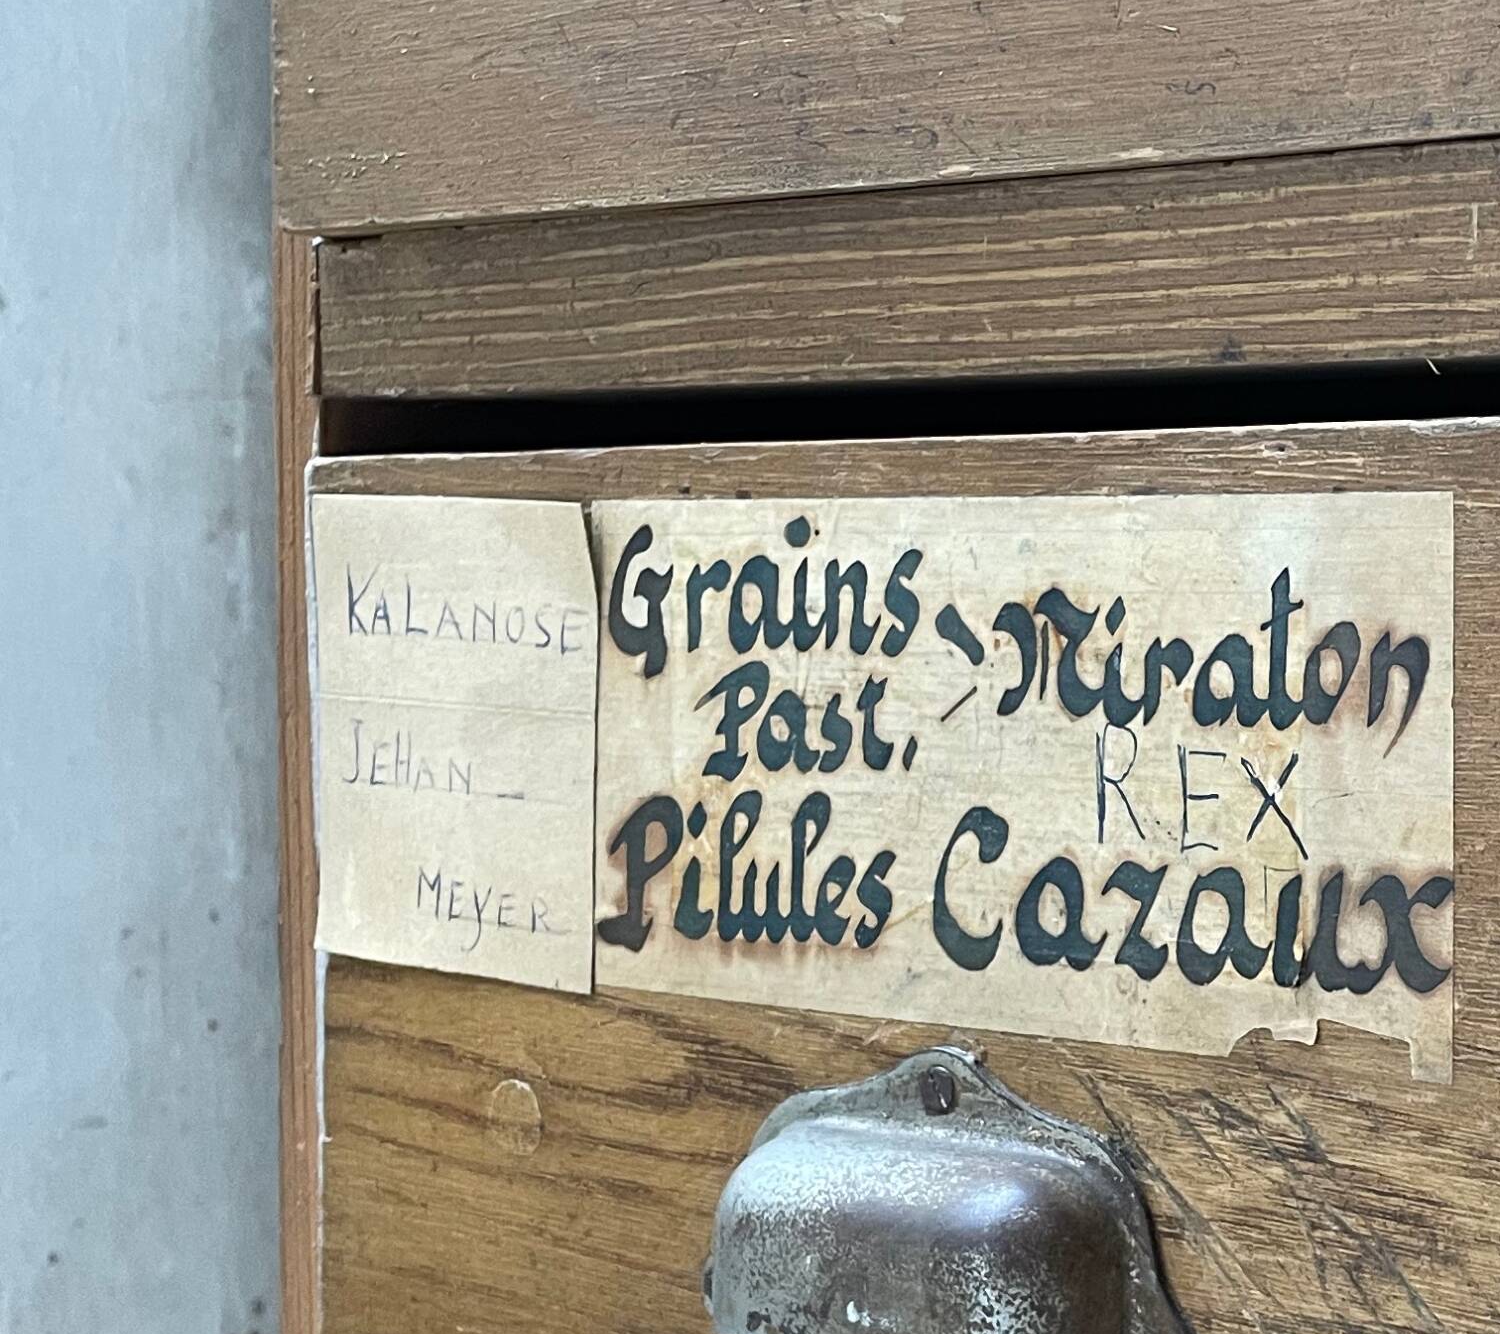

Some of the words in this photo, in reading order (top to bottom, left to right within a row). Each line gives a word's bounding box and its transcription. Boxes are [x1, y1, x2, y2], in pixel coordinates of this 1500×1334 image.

[344, 561, 590, 656] KALANOSE
[608, 515, 924, 679] Grains
[991, 566, 1431, 759] Miraton
[342, 717, 474, 797] JEHAN
[1094, 722, 1309, 860] REX
[417, 865, 570, 952] MEYER
[596, 789, 897, 953] Pilules
[932, 805, 1454, 995] Cazaux
